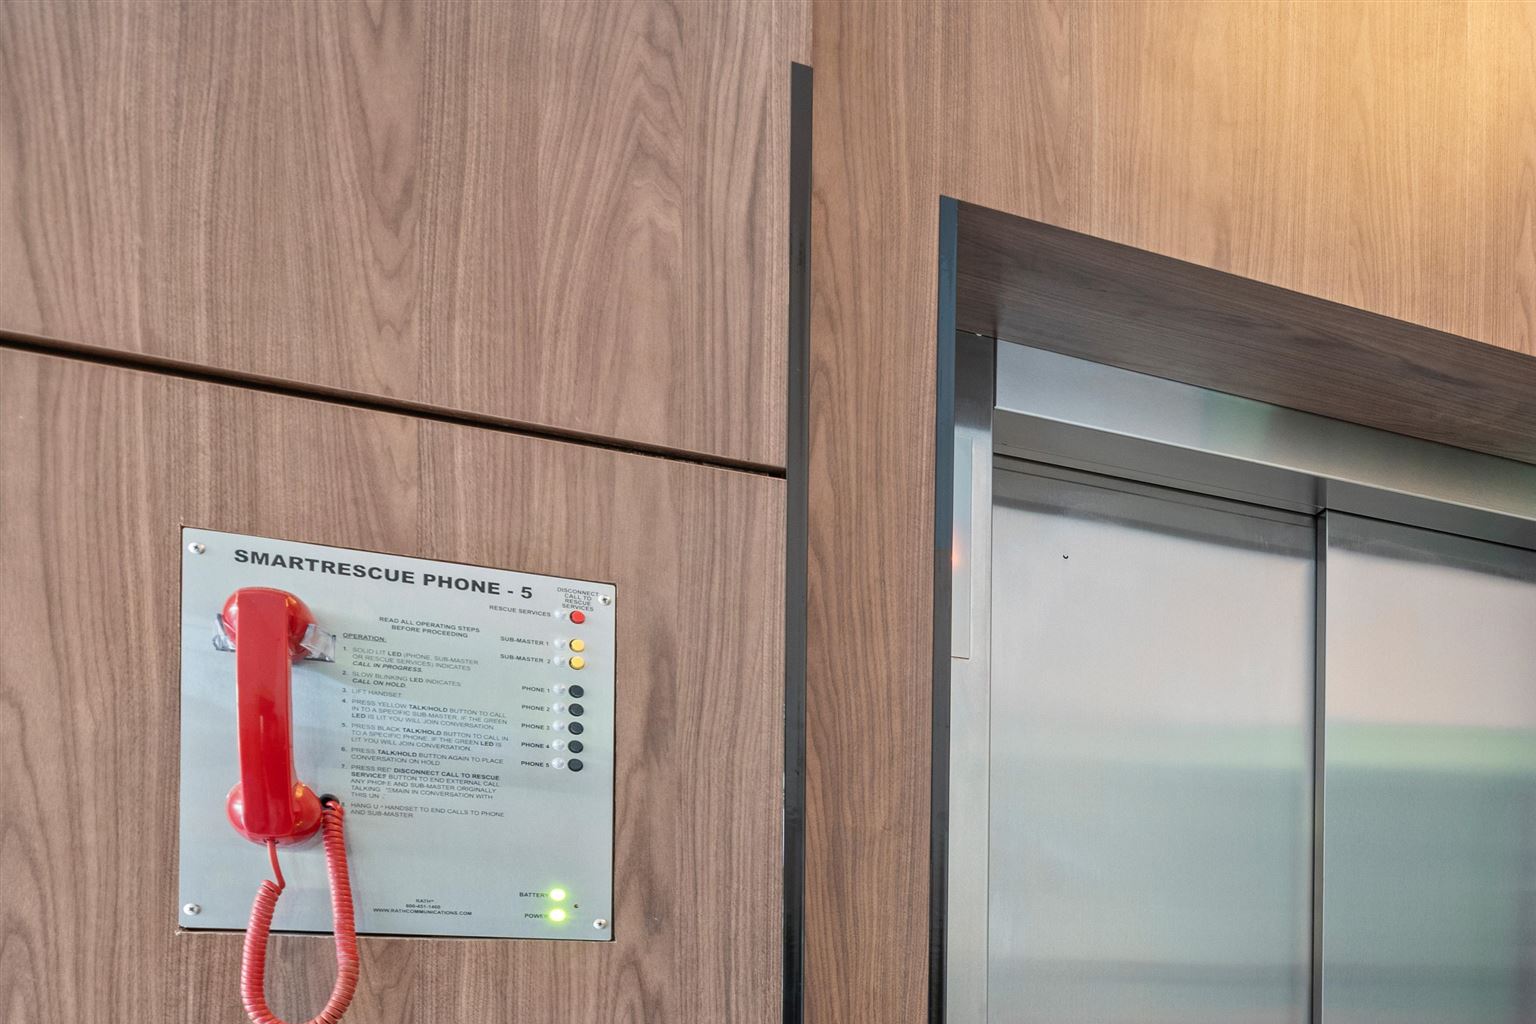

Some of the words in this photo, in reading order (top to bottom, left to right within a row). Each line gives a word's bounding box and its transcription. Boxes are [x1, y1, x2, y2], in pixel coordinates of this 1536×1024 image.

[234, 549, 414, 585] SMARTRESCUE
[423, 573, 501, 595] PHONE
[521, 586, 533, 599] 5
[557, 587, 599, 596] DISCONNECT
[489, 605, 516, 613] RESCUE
[518, 608, 551, 617] SERVICES
[562, 603, 594, 611] SERVICES
[392, 625, 420, 633] BEFORE
[422, 628, 468, 638] PROCEEDING
[416, 620, 456, 630] OPERATING
[458, 625, 480, 633] STEPS
[501, 636, 545, 646] SUB-MASTER
[365, 655, 393, 663] RESCUE
[435, 662, 471, 671] INDICATES
[500, 653, 544, 663] SUB-MASTER
[393, 768, 439, 776] DISCONNECT
[384, 804, 418, 812] HANDSET
